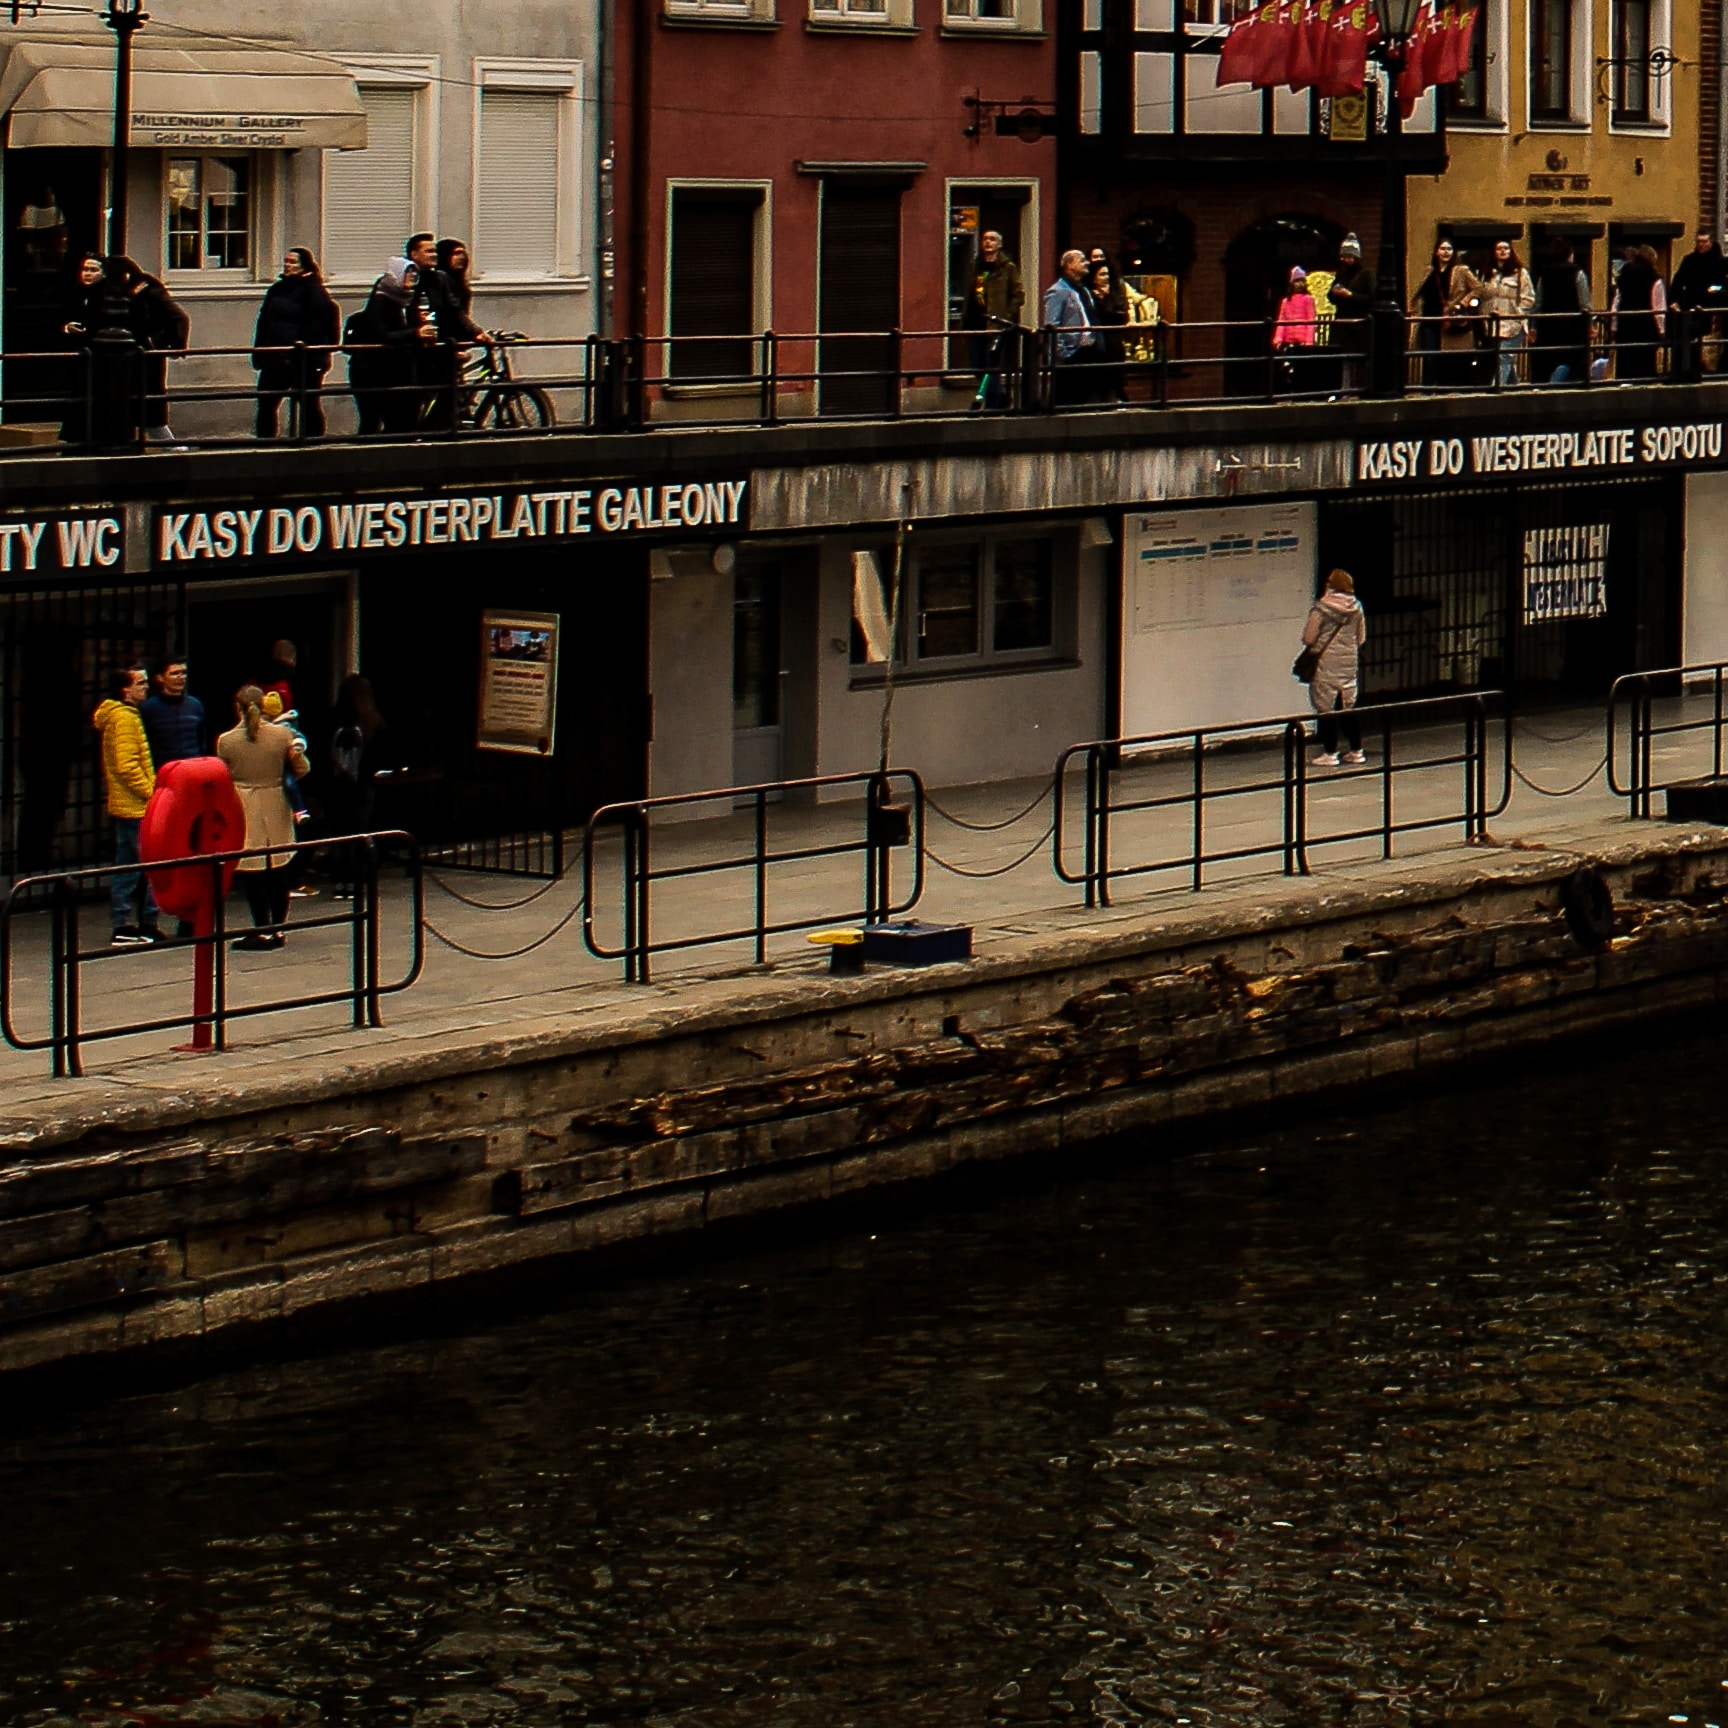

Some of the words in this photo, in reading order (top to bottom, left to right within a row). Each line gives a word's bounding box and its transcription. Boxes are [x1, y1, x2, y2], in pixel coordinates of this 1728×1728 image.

[154, 132, 180, 145] Gold
[182, 133, 217, 145] Amber
[250, 133, 285, 146] Crystal
[238, 116, 304, 128] GALLERY
[1358, 440, 1422, 480] KASY
[1430, 438, 1464, 475] DO
[1472, 429, 1634, 472] WESTERPLATTE
[1641, 423, 1722, 463] SOPOTU
[58, 518, 121, 567] WC
[160, 509, 263, 561] KASY
[268, 506, 322, 554] DO
[328, 490, 592, 549] WESTERPLATTE
[598, 480, 747, 532] GALEONY
